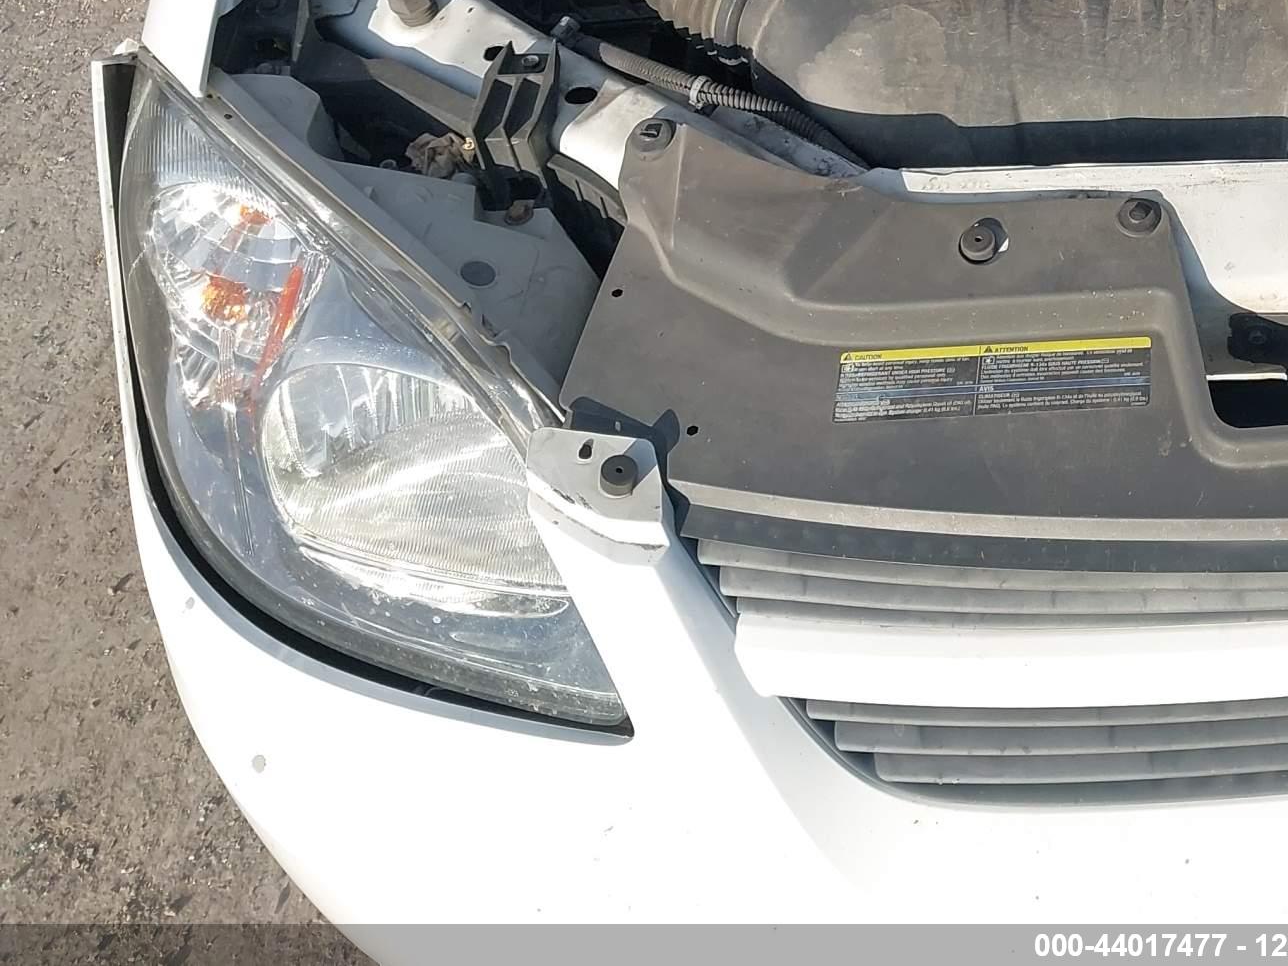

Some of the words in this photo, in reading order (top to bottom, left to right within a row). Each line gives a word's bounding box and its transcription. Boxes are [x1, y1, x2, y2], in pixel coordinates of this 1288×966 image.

[994, 345, 1029, 354] ATTENTION
[854, 353, 883, 361] CAUTION
[979, 385, 994, 393] AVIS
